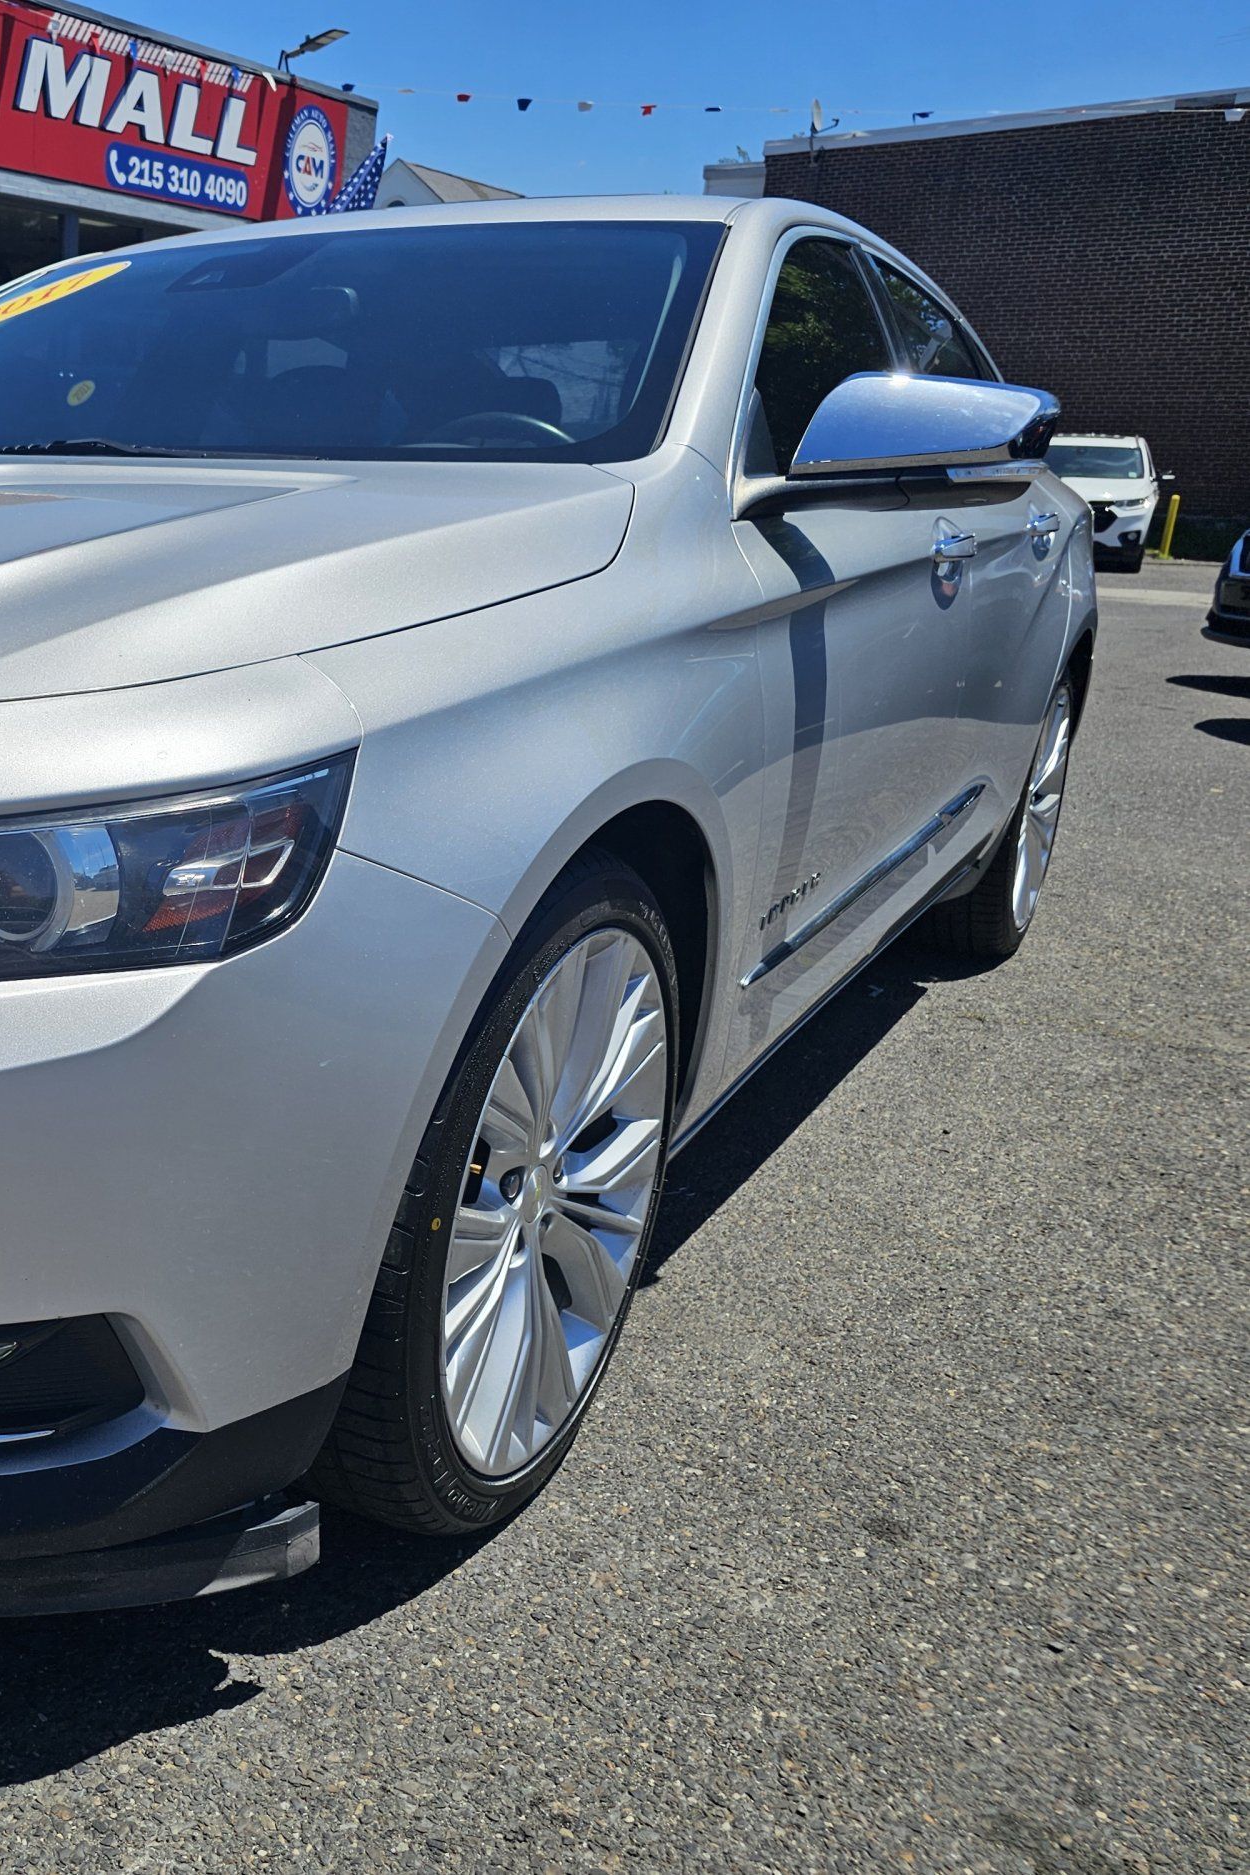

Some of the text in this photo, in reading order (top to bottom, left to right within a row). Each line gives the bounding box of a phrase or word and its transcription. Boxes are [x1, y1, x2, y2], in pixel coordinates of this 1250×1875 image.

[15, 37, 258, 166] MALL
[128, 155, 248, 207] 215 310 4090
[296, 154, 325, 179] CAM
